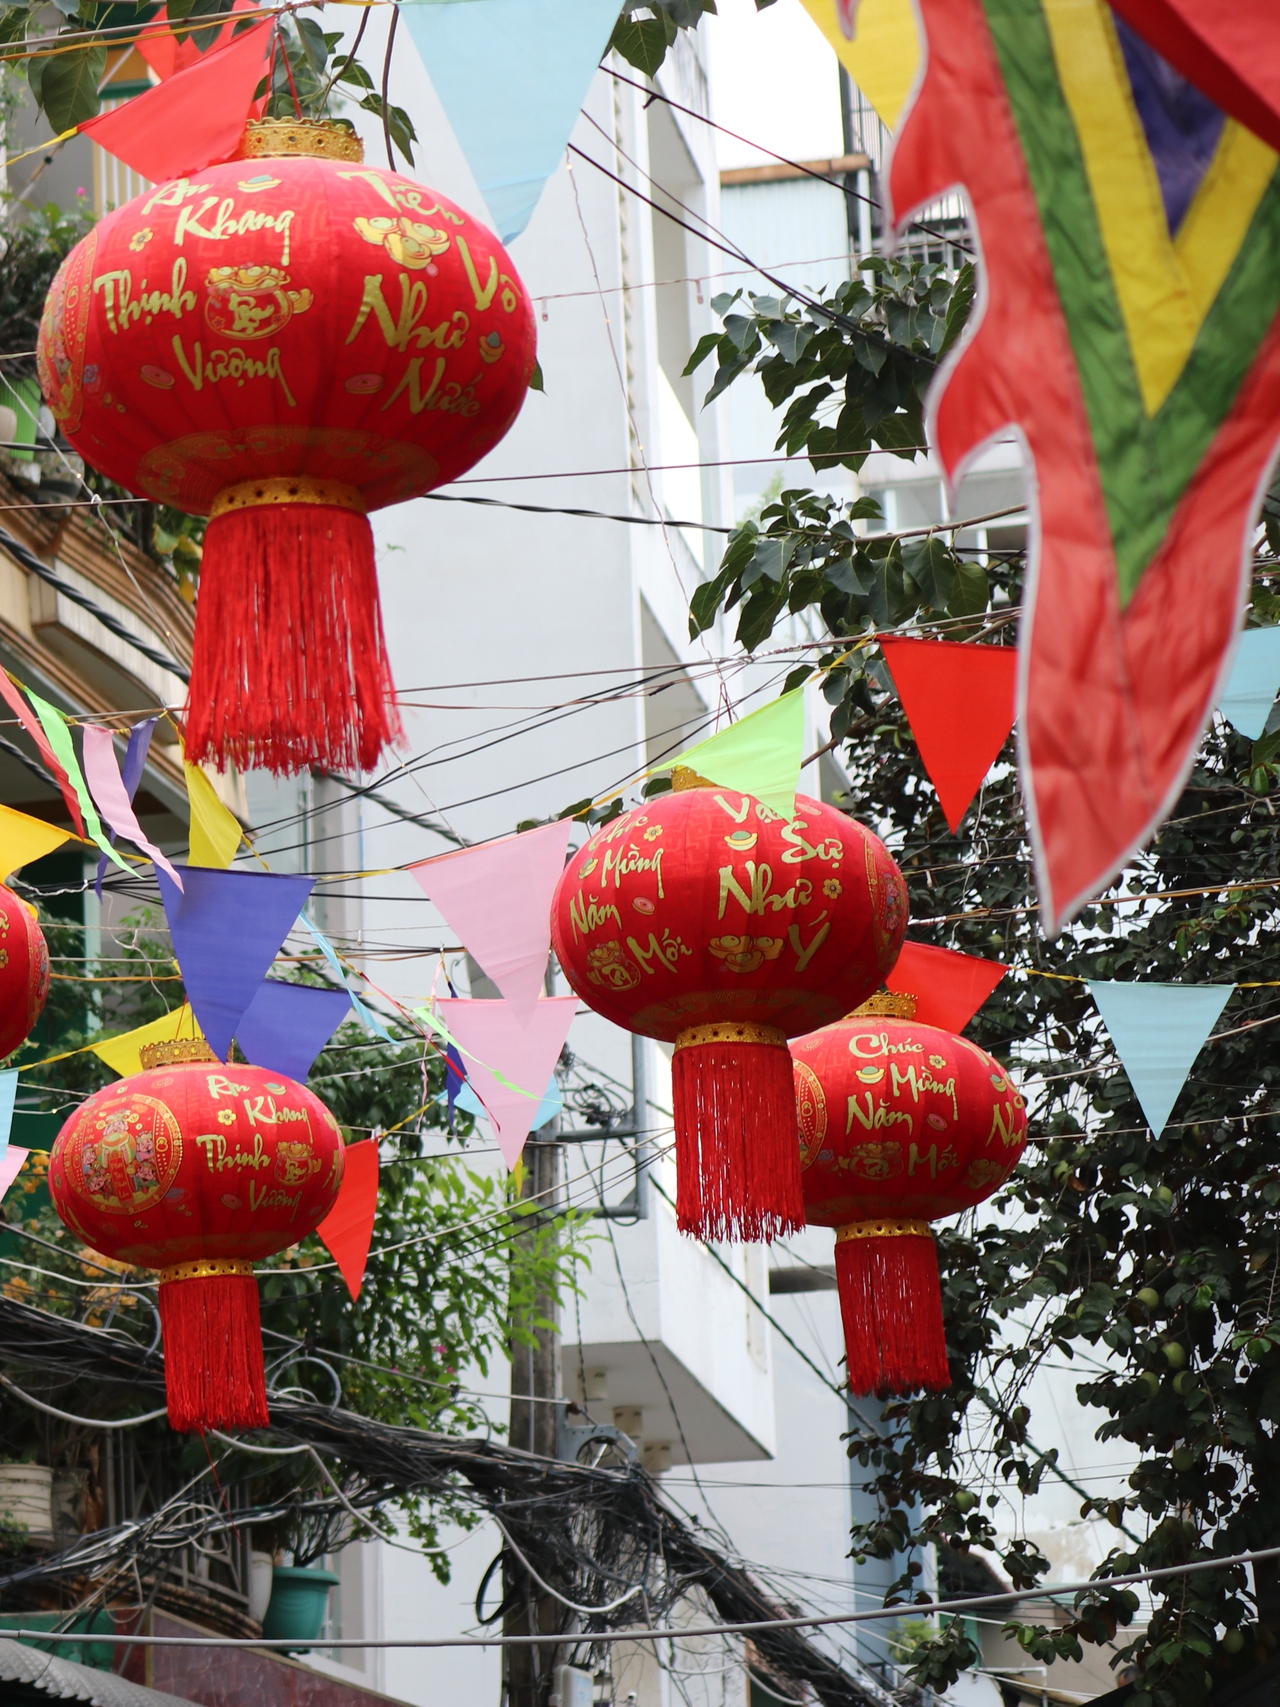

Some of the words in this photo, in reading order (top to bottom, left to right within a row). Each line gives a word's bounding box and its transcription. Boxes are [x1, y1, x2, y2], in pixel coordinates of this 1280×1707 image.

[141, 177, 215, 215] An
[173, 197, 295, 266] Khang
[94, 257, 197, 334] Thịnh
[455, 236, 523, 313] Vô
[345, 272, 470, 353] Như
[172, 334, 297, 407] Vượng
[381, 356, 484, 417] Nước
[713, 795, 802, 824] Vạ
[601, 843, 665, 899] Mừng
[781, 820, 845, 870] Sự
[717, 860, 813, 921] Như
[570, 890, 623, 945] Năm
[787, 909, 831, 973] Ý
[627, 928, 693, 975] Mới
[849, 1033, 925, 1059] Chúc
[206, 1074, 251, 1100] An
[890, 1062, 959, 1121] Mừng
[243, 1095, 314, 1144] Khang
[846, 1091, 913, 1136] Năm
[196, 1132, 272, 1174] Thịnh
[909, 1143, 961, 1180] Mới
[249, 1179, 303, 1222] Vượng
